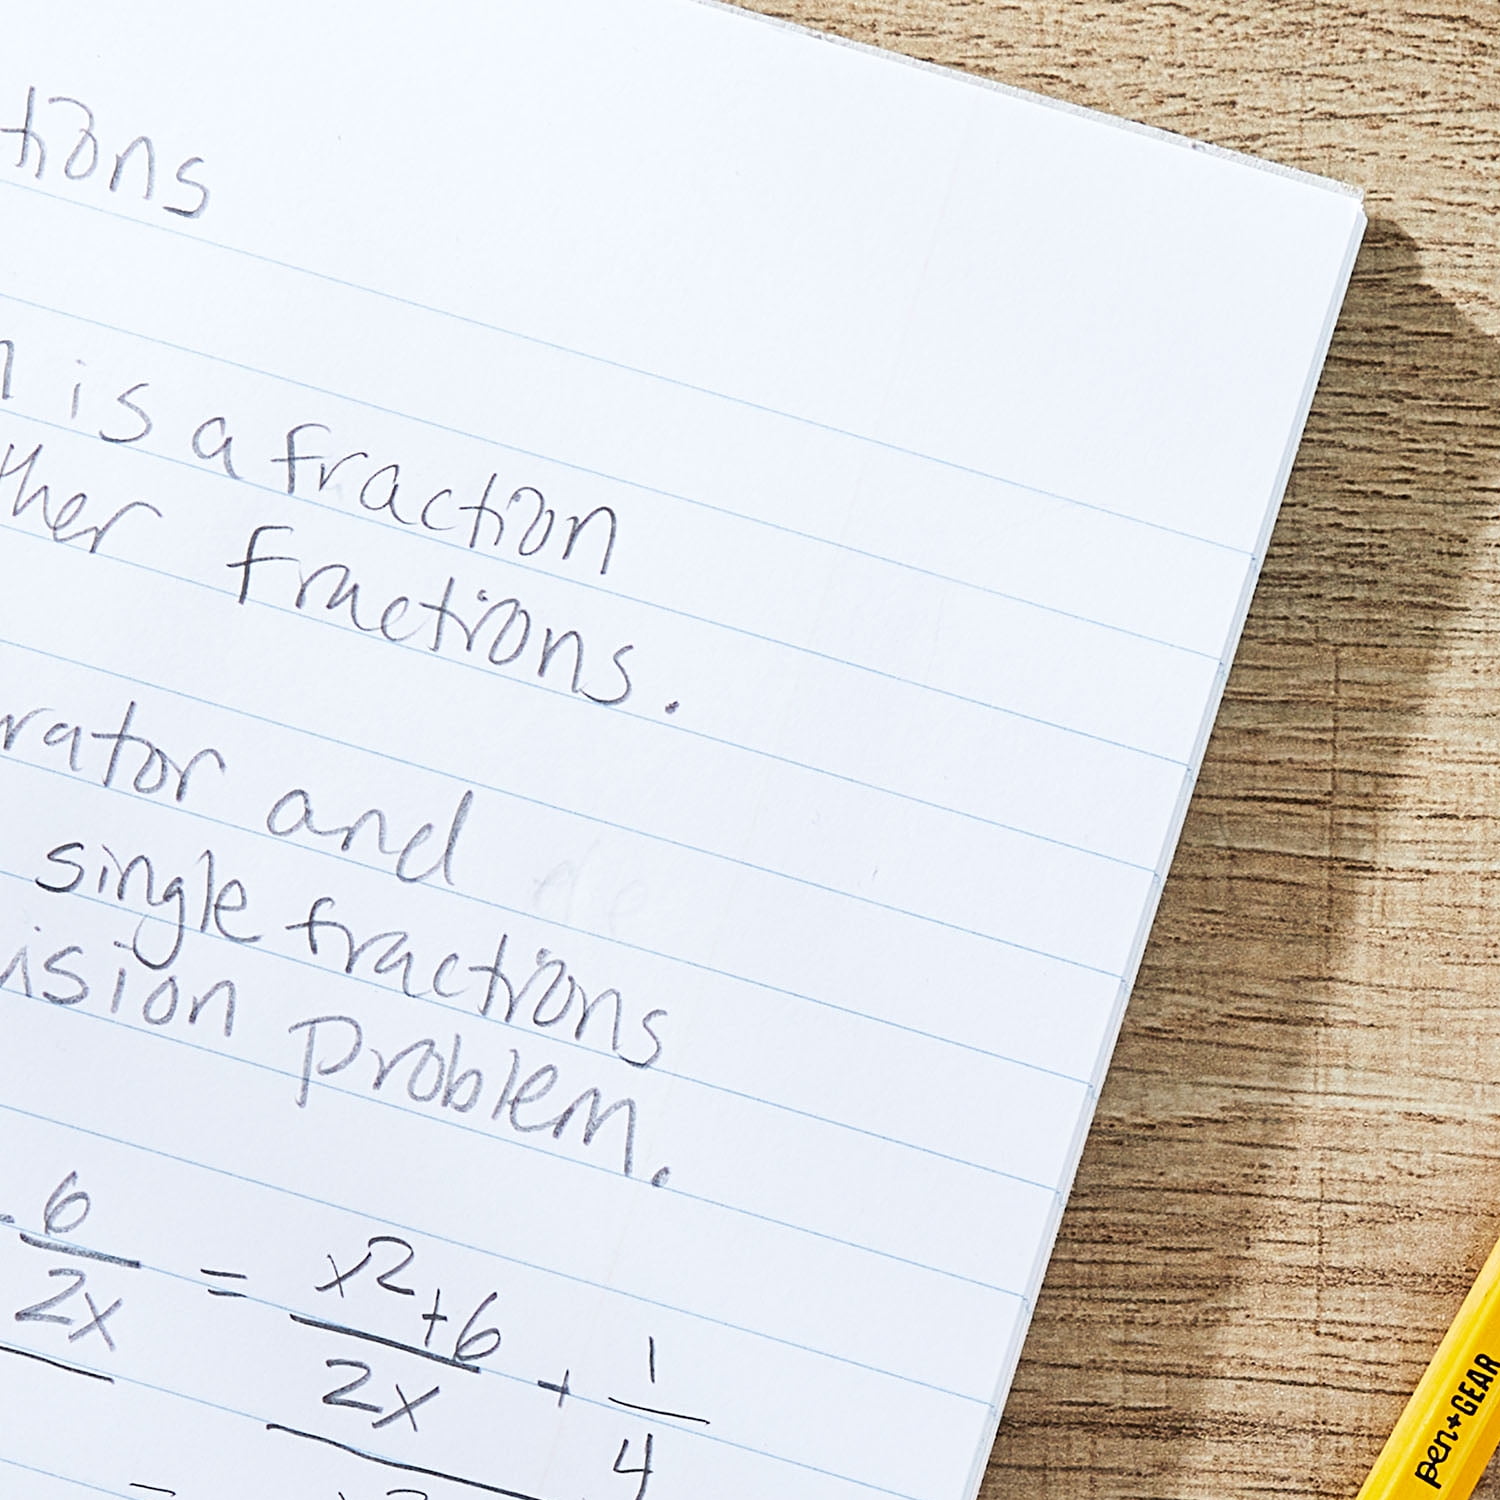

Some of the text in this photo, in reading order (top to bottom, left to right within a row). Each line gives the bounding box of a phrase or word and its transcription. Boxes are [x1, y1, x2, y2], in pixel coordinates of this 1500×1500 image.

[69, 358, 154, 443] is
[192, 415, 242, 480] a
[270, 422, 618, 575] fraction
[0, 700, 226, 802] rator
[266, 788, 473, 887] and
[35, 841, 669, 1069] single fractions
[288, 1015, 672, 1188] problem.
